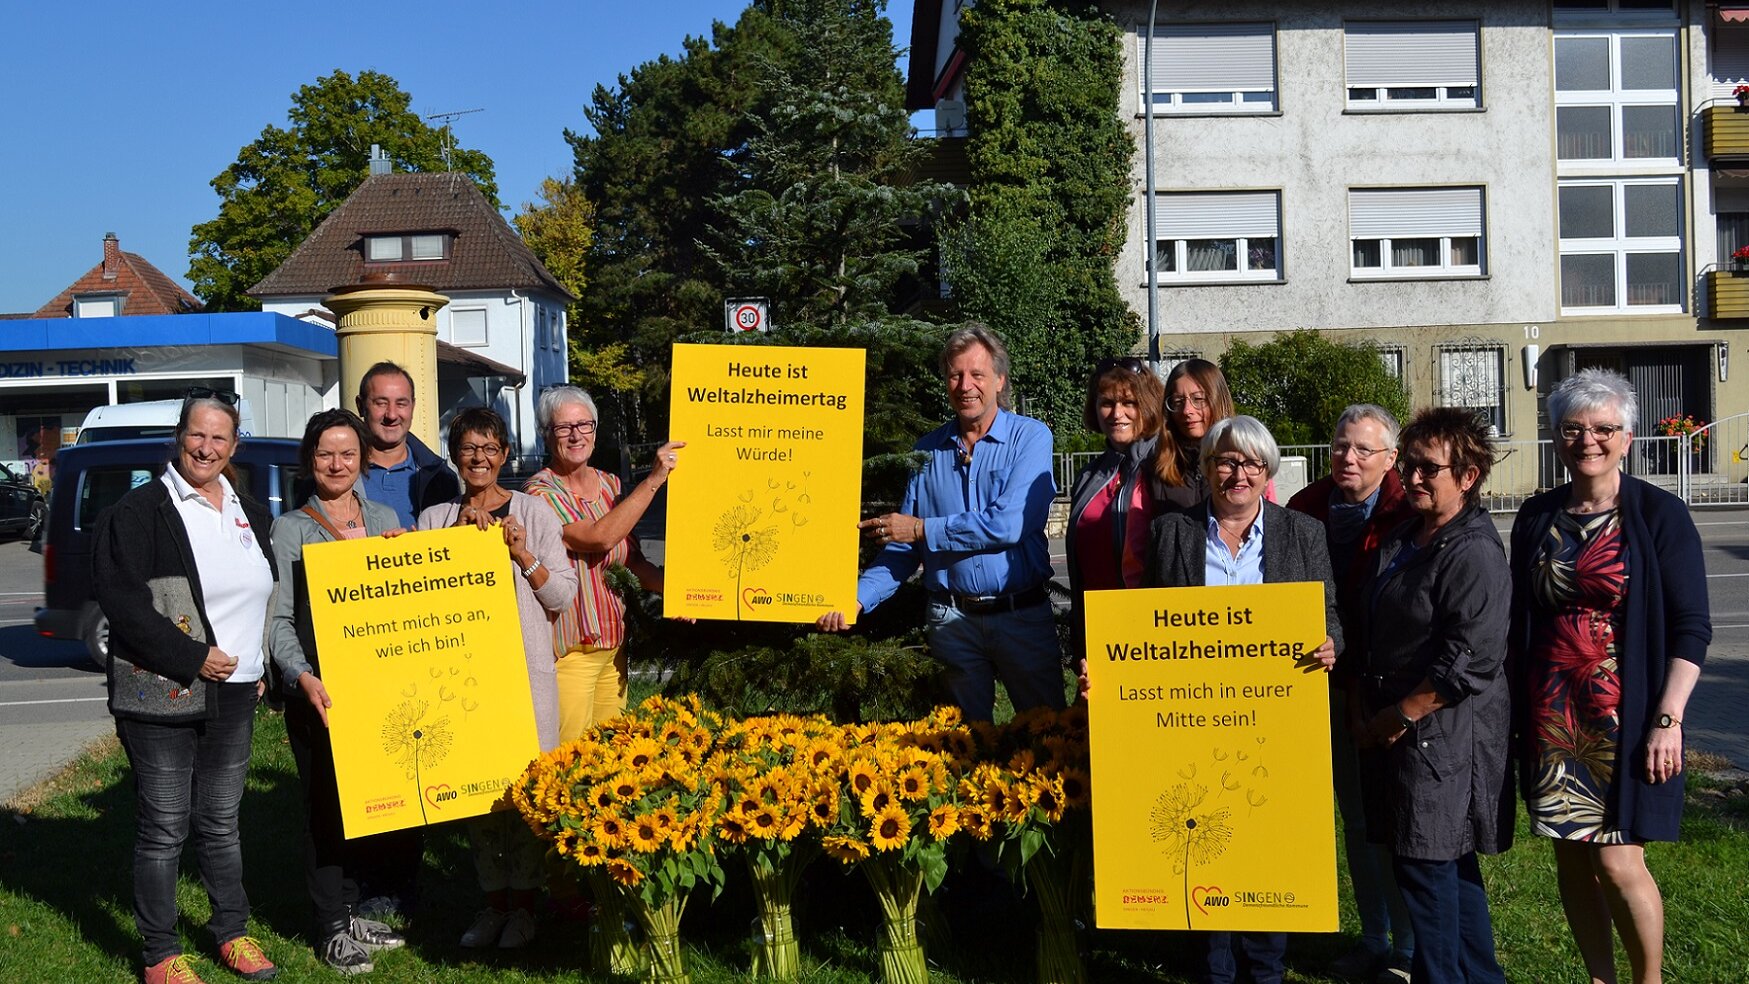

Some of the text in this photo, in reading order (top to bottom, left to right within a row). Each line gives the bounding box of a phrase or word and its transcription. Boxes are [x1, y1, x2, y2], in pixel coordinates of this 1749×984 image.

[741, 312, 756, 324] 30
[1524, 326, 1539, 339] 10
[56, 358, 135, 376] TECHNIK
[729, 363, 807, 379] Heute ist
[688, 388, 846, 410] Weltalzheimertag
[708, 424, 823, 440] Lasst mir meine
[737, 448, 791, 461] Würde!
[367, 547, 450, 570] Heute ist
[327, 570, 496, 603] Weltalzheimertag
[752, 596, 772, 605] AWO
[777, 594, 813, 603] SINGEN
[344, 610, 489, 638] Nehmt mich so an,
[1155, 607, 1252, 627] Heute ist
[376, 633, 466, 658] wie ich bin!
[1106, 640, 1305, 662] Weltalzheimertag
[1120, 683, 1292, 700] Lasst mich in eurer
[1157, 710, 1255, 727] Mitte sein!
[461, 779, 500, 794] SINGEN
[436, 791, 457, 802] AWO
[1204, 896, 1229, 906] AWO
[1235, 892, 1281, 903] SINGEN
